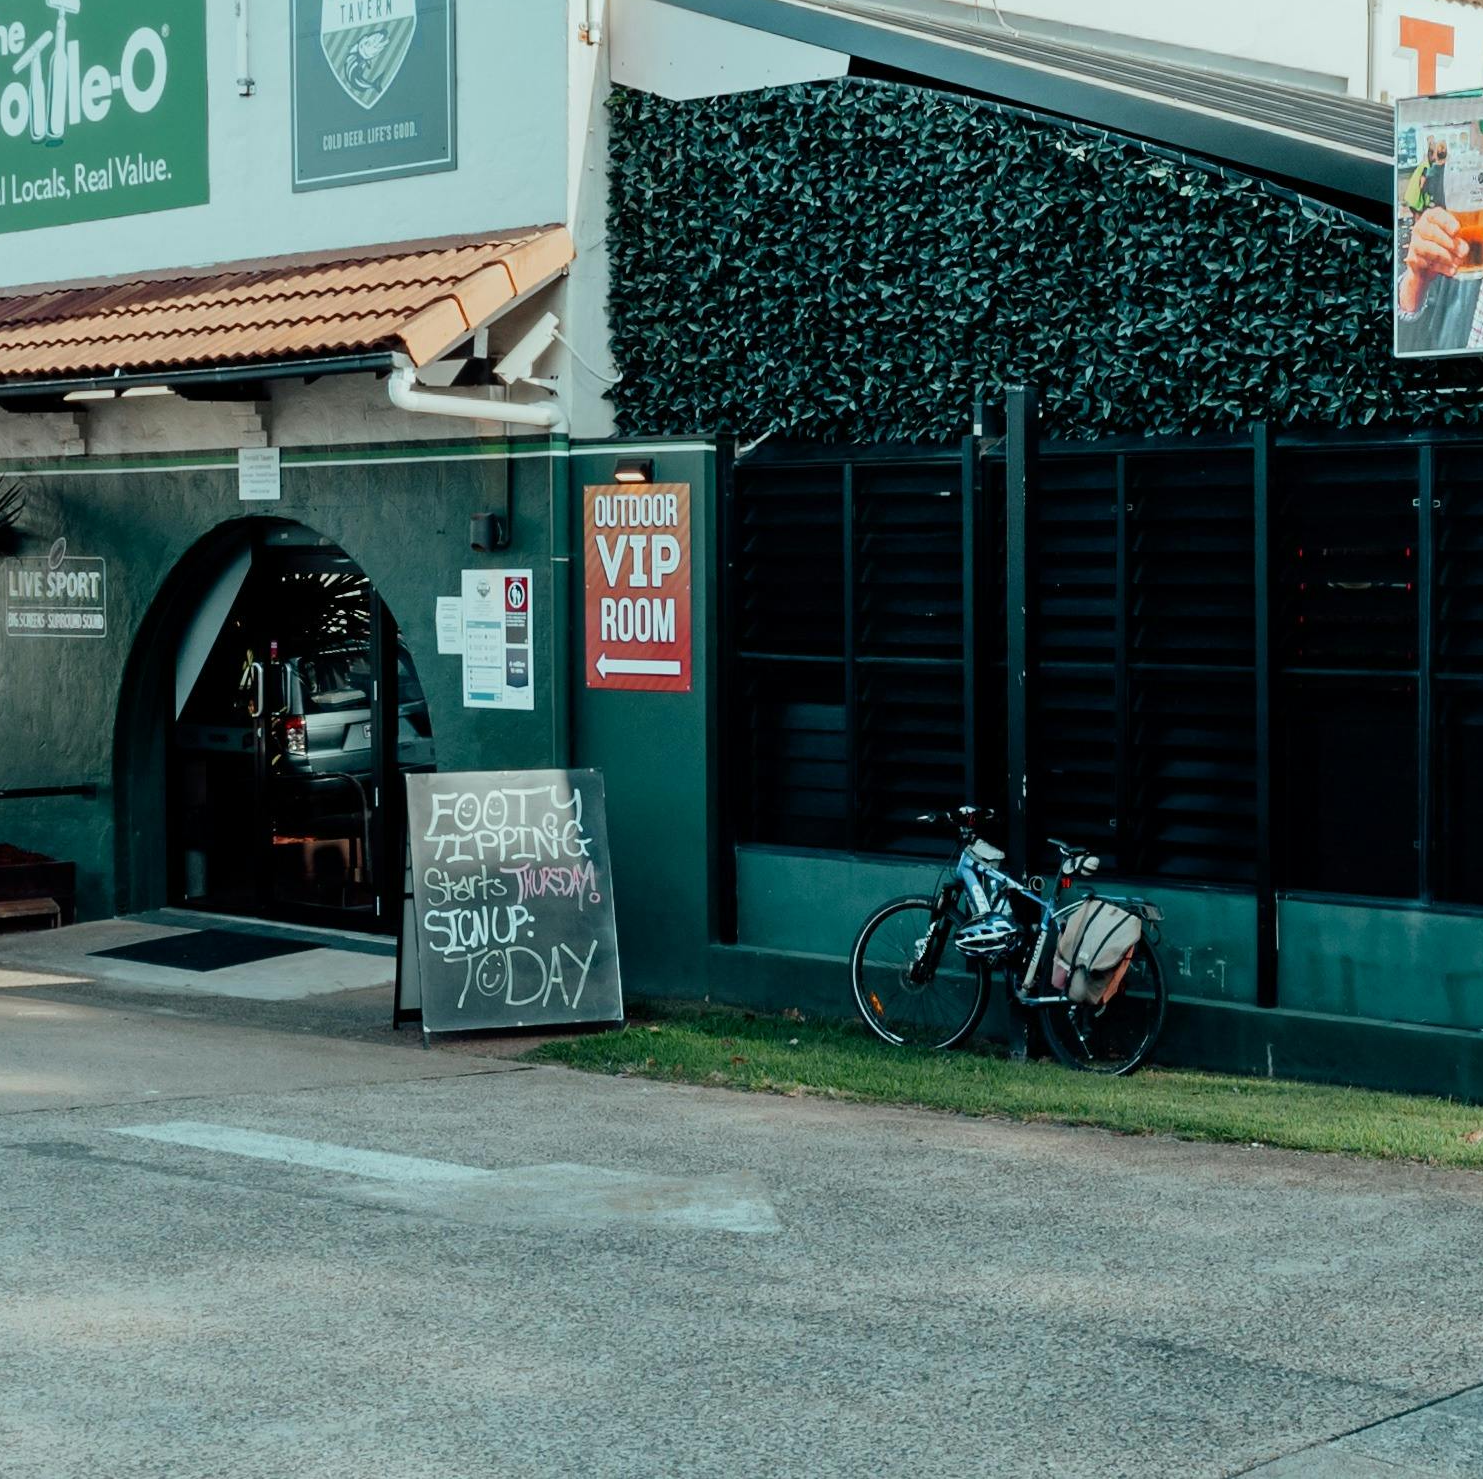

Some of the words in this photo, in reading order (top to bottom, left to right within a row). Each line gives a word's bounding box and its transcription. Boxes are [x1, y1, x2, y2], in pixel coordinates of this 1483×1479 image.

[322, 132, 343, 152] COLD
[368, 124, 392, 145] LIFE'S
[393, 120, 418, 141] GOOD.
[11, 167, 71, 201] Locals,
[74, 157, 114, 195] Real
[114, 152, 173, 187] Value.
[594, 493, 678, 529] OUTDOOR
[594, 534, 682, 588] VIP
[8, 571, 44, 598] LIVE
[45, 571, 102, 599] SPORT
[600, 597, 677, 643] ROOM
[427, 784, 584, 837] FOOTY
[423, 818, 594, 864] TIPPING
[424, 865, 508, 906] Starts
[499, 860, 602, 912] THURSDAY!
[491, 904, 536, 943] UP:
[443, 939, 599, 1010] TODAY
